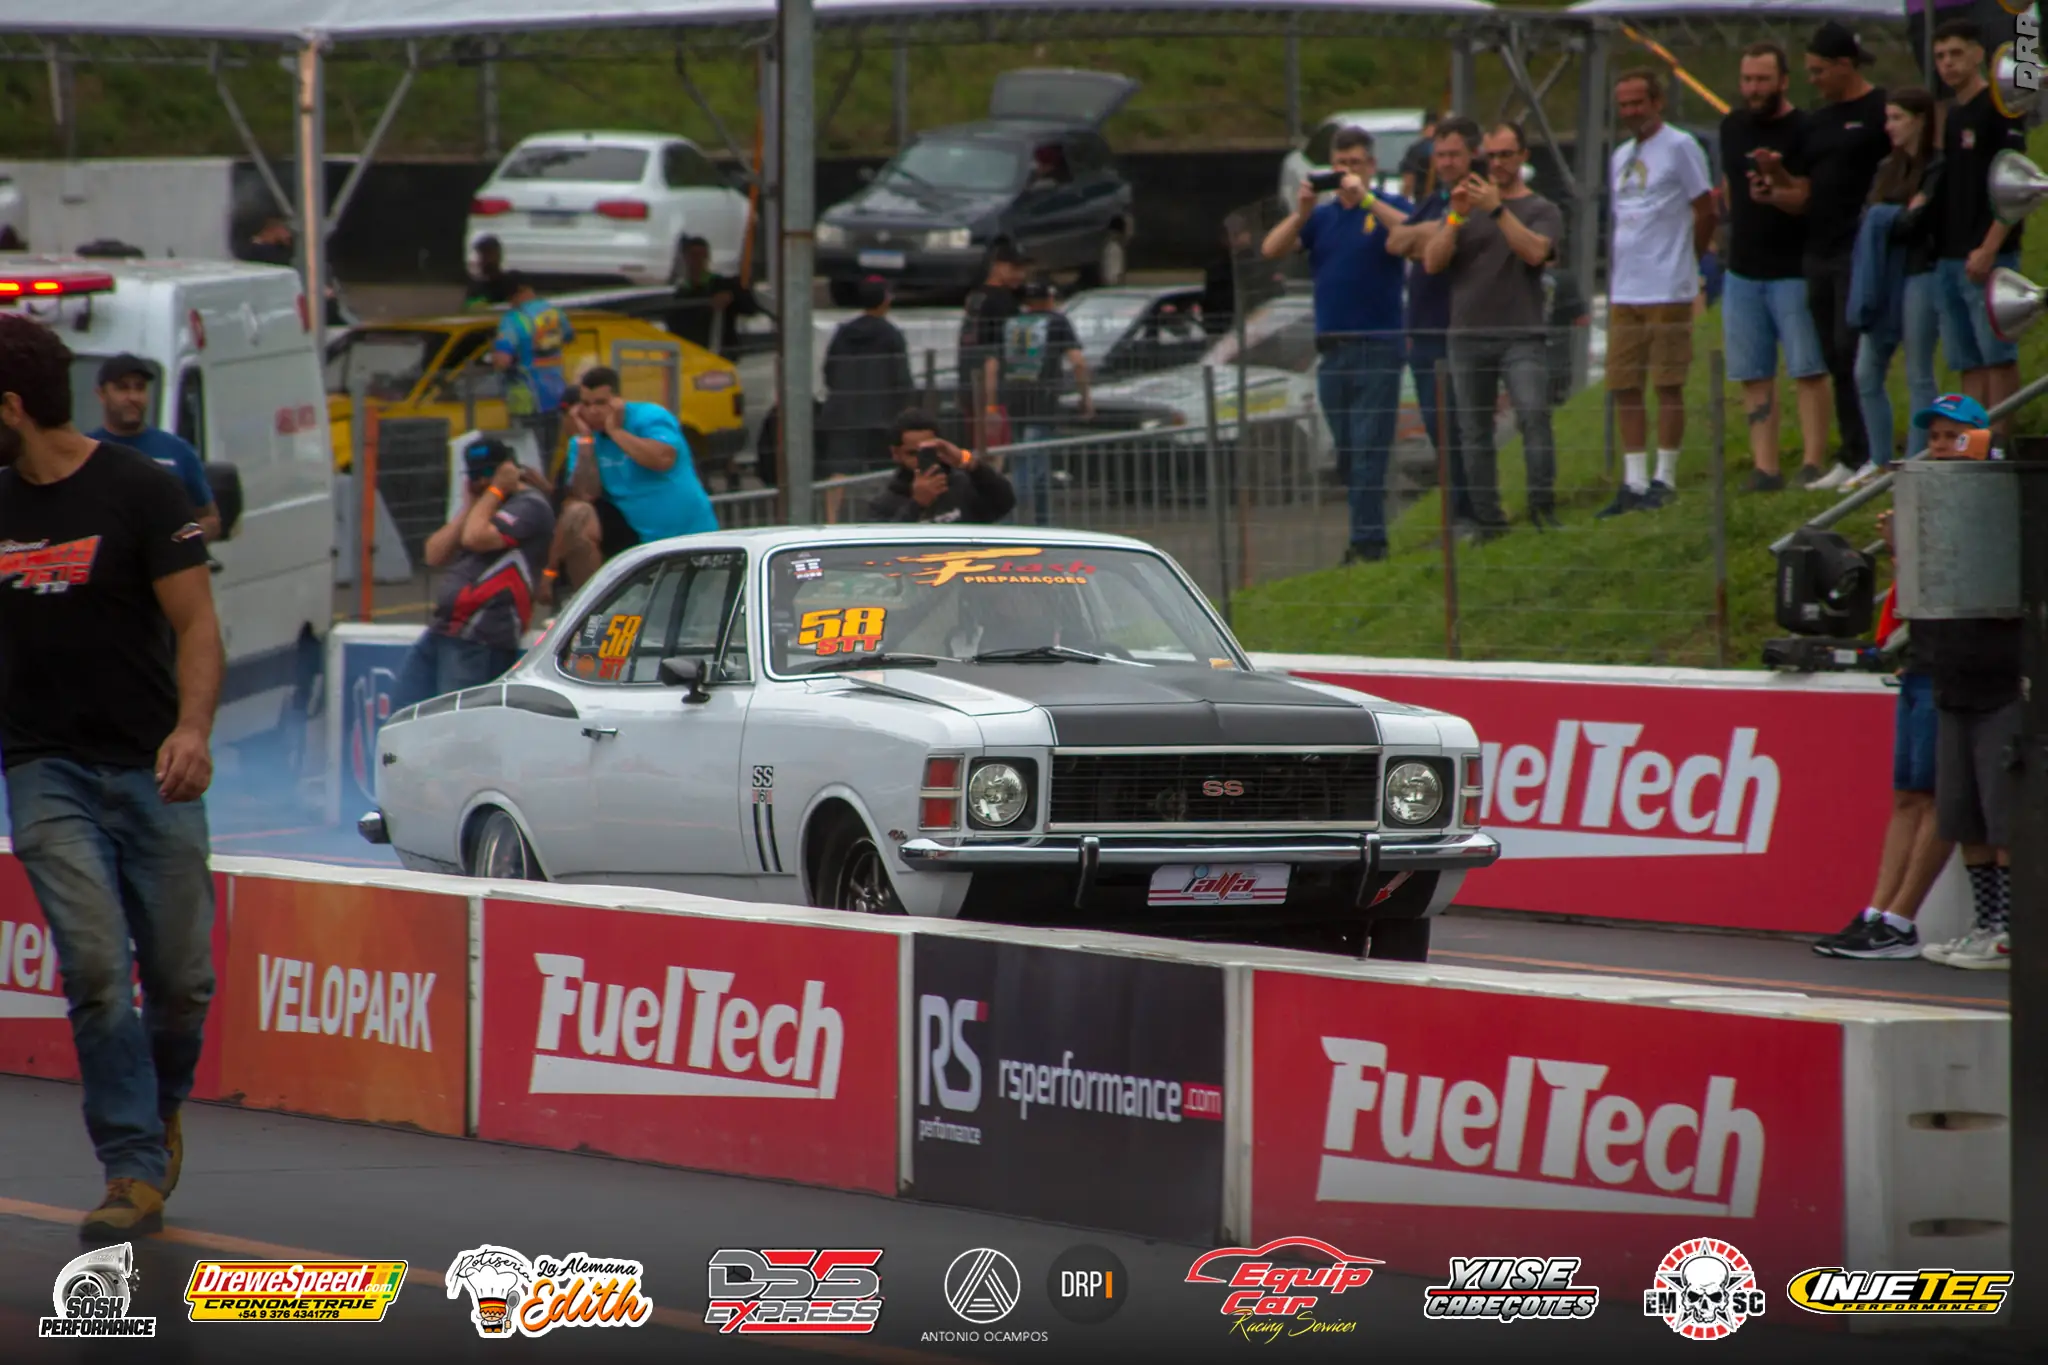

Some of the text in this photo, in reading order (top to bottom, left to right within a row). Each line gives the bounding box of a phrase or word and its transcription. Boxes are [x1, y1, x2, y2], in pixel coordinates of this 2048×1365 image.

[597, 614, 643, 660] 58
[798, 607, 887, 645] 58
[815, 635, 883, 656] STT
[753, 766, 772, 787] SS
[1202, 780, 1244, 797] SS
[258, 953, 436, 1052] VELOPARK
[533, 952, 844, 1099] FuelTech
[919, 994, 989, 1112] RS
[1320, 1036, 1765, 1217] FuelTech
